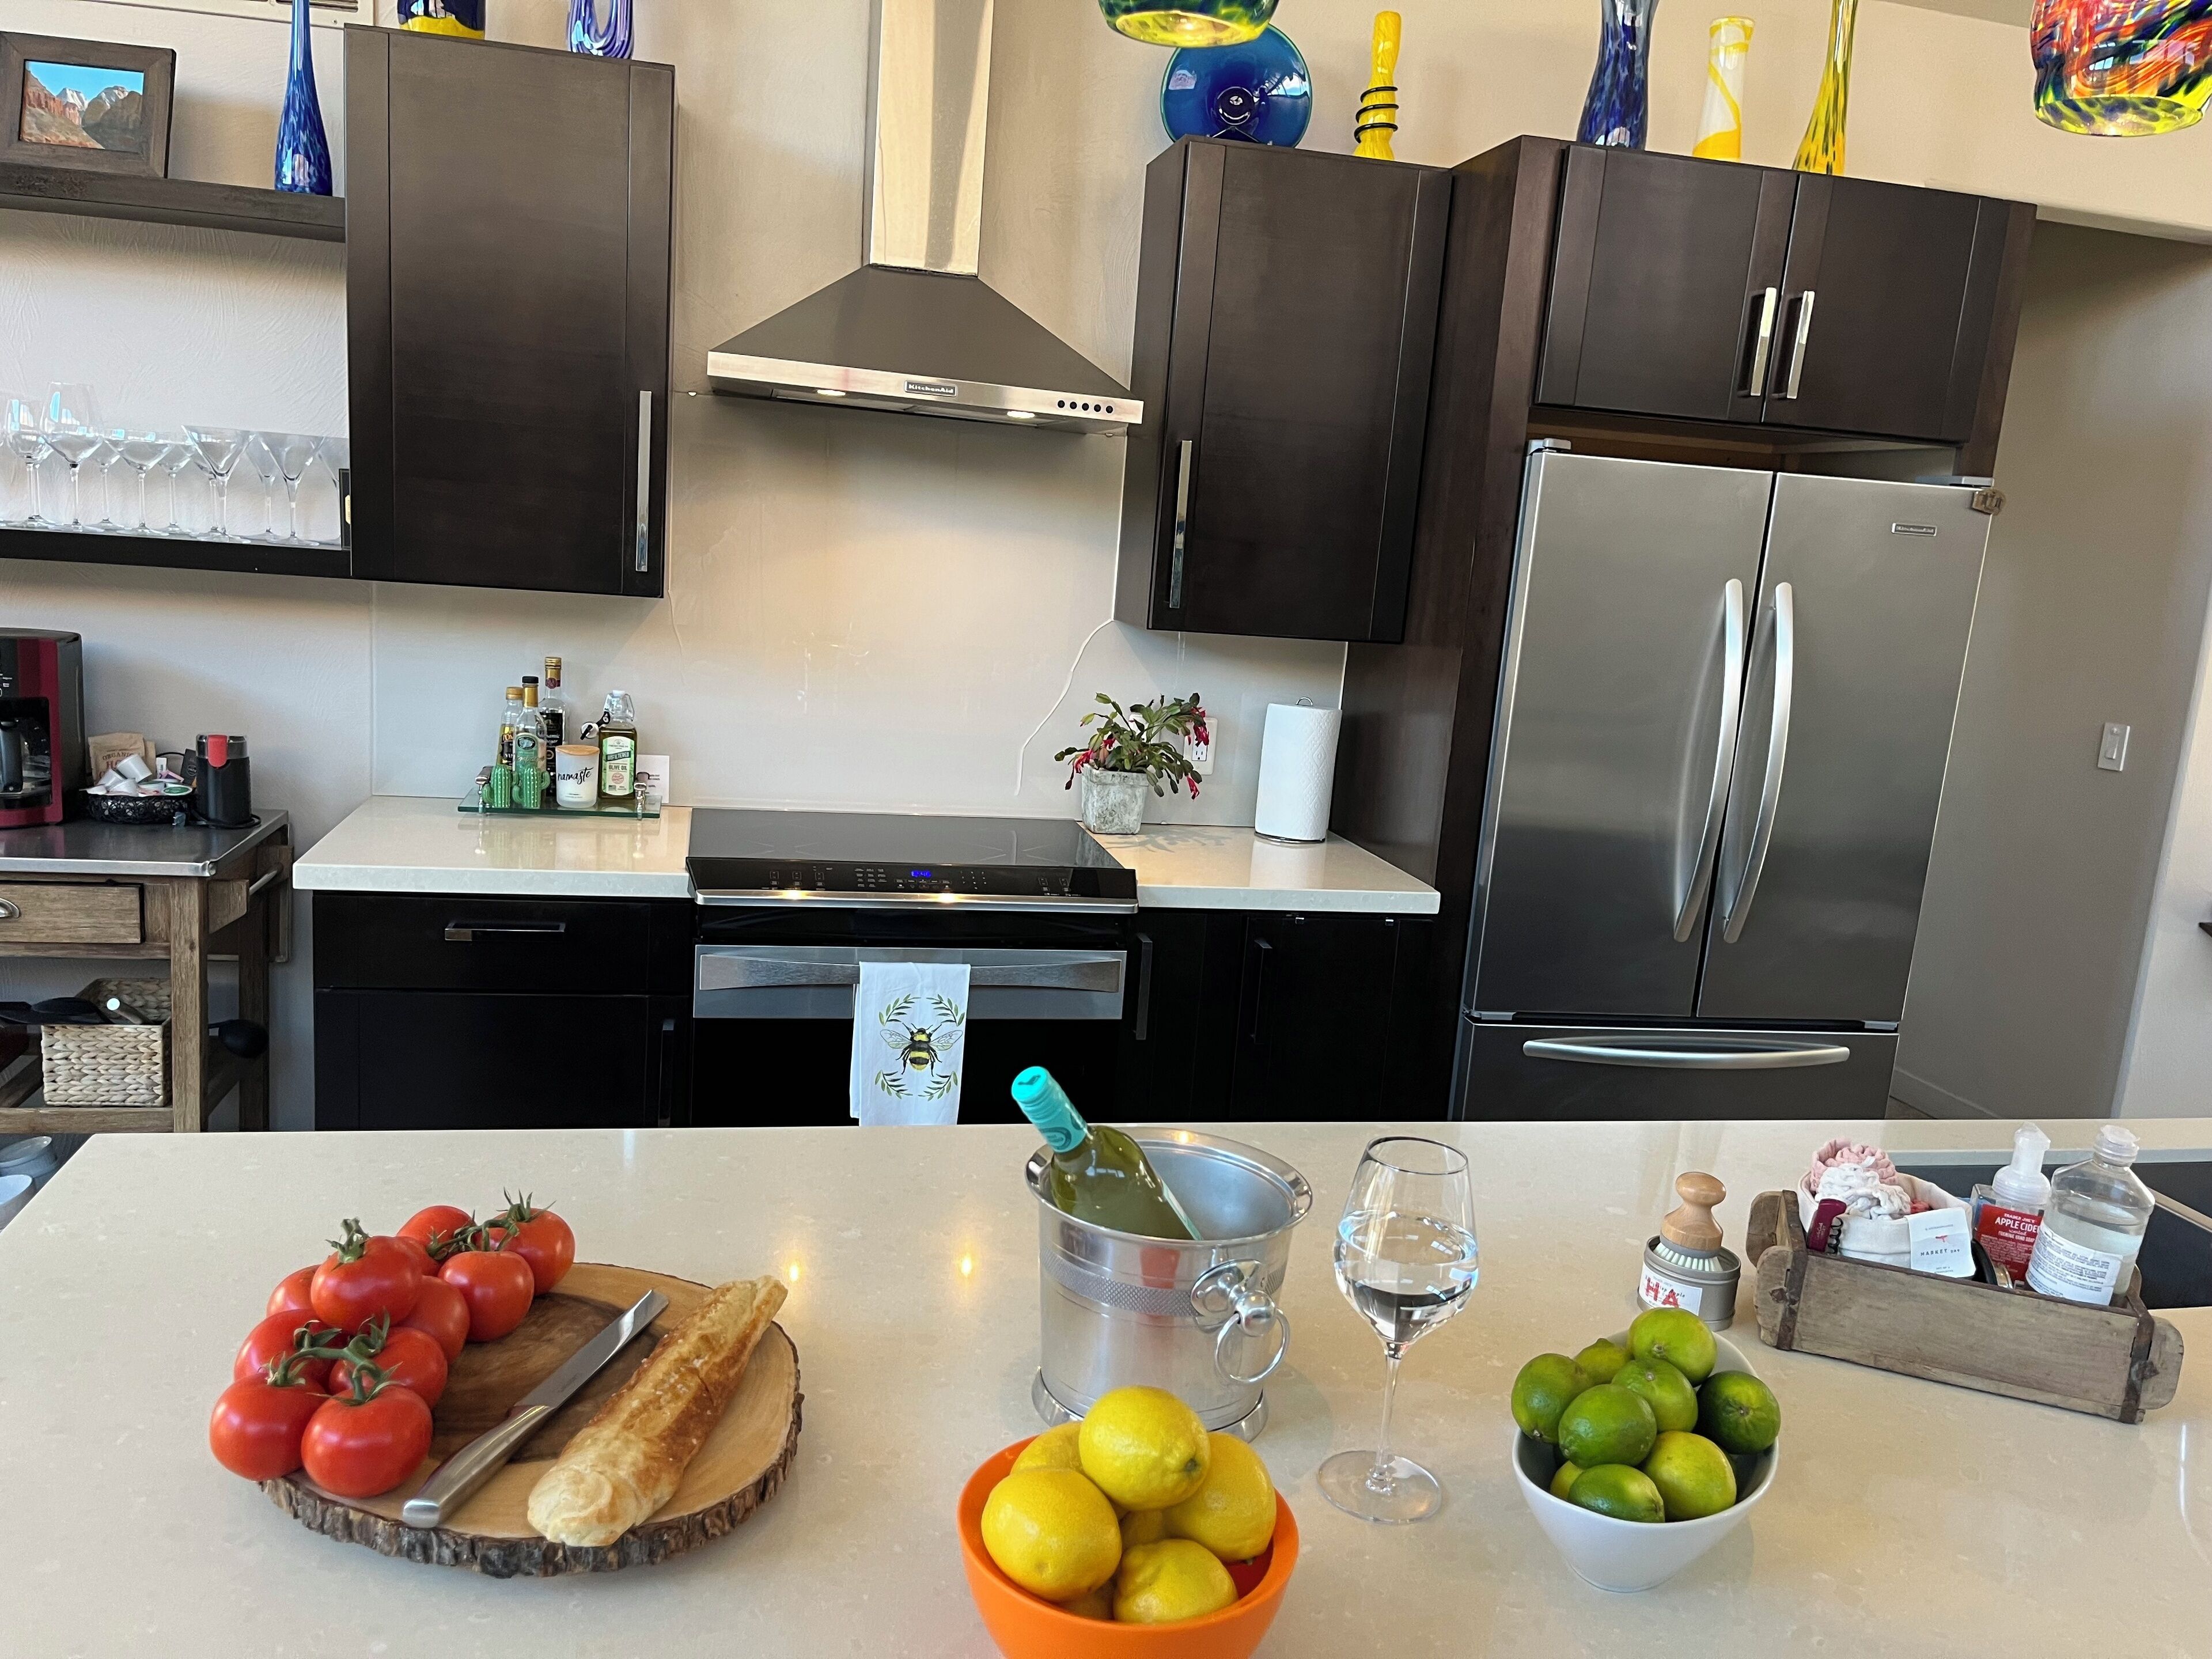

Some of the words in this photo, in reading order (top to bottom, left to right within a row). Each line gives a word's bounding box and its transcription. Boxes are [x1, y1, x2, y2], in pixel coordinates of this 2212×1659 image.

[908, 384, 953, 393] KitchenAid
[558, 767, 594, 785] namaste
[1995, 1217, 2020, 1229] APPLE
[1920, 1248, 1948, 1256] MARKET
